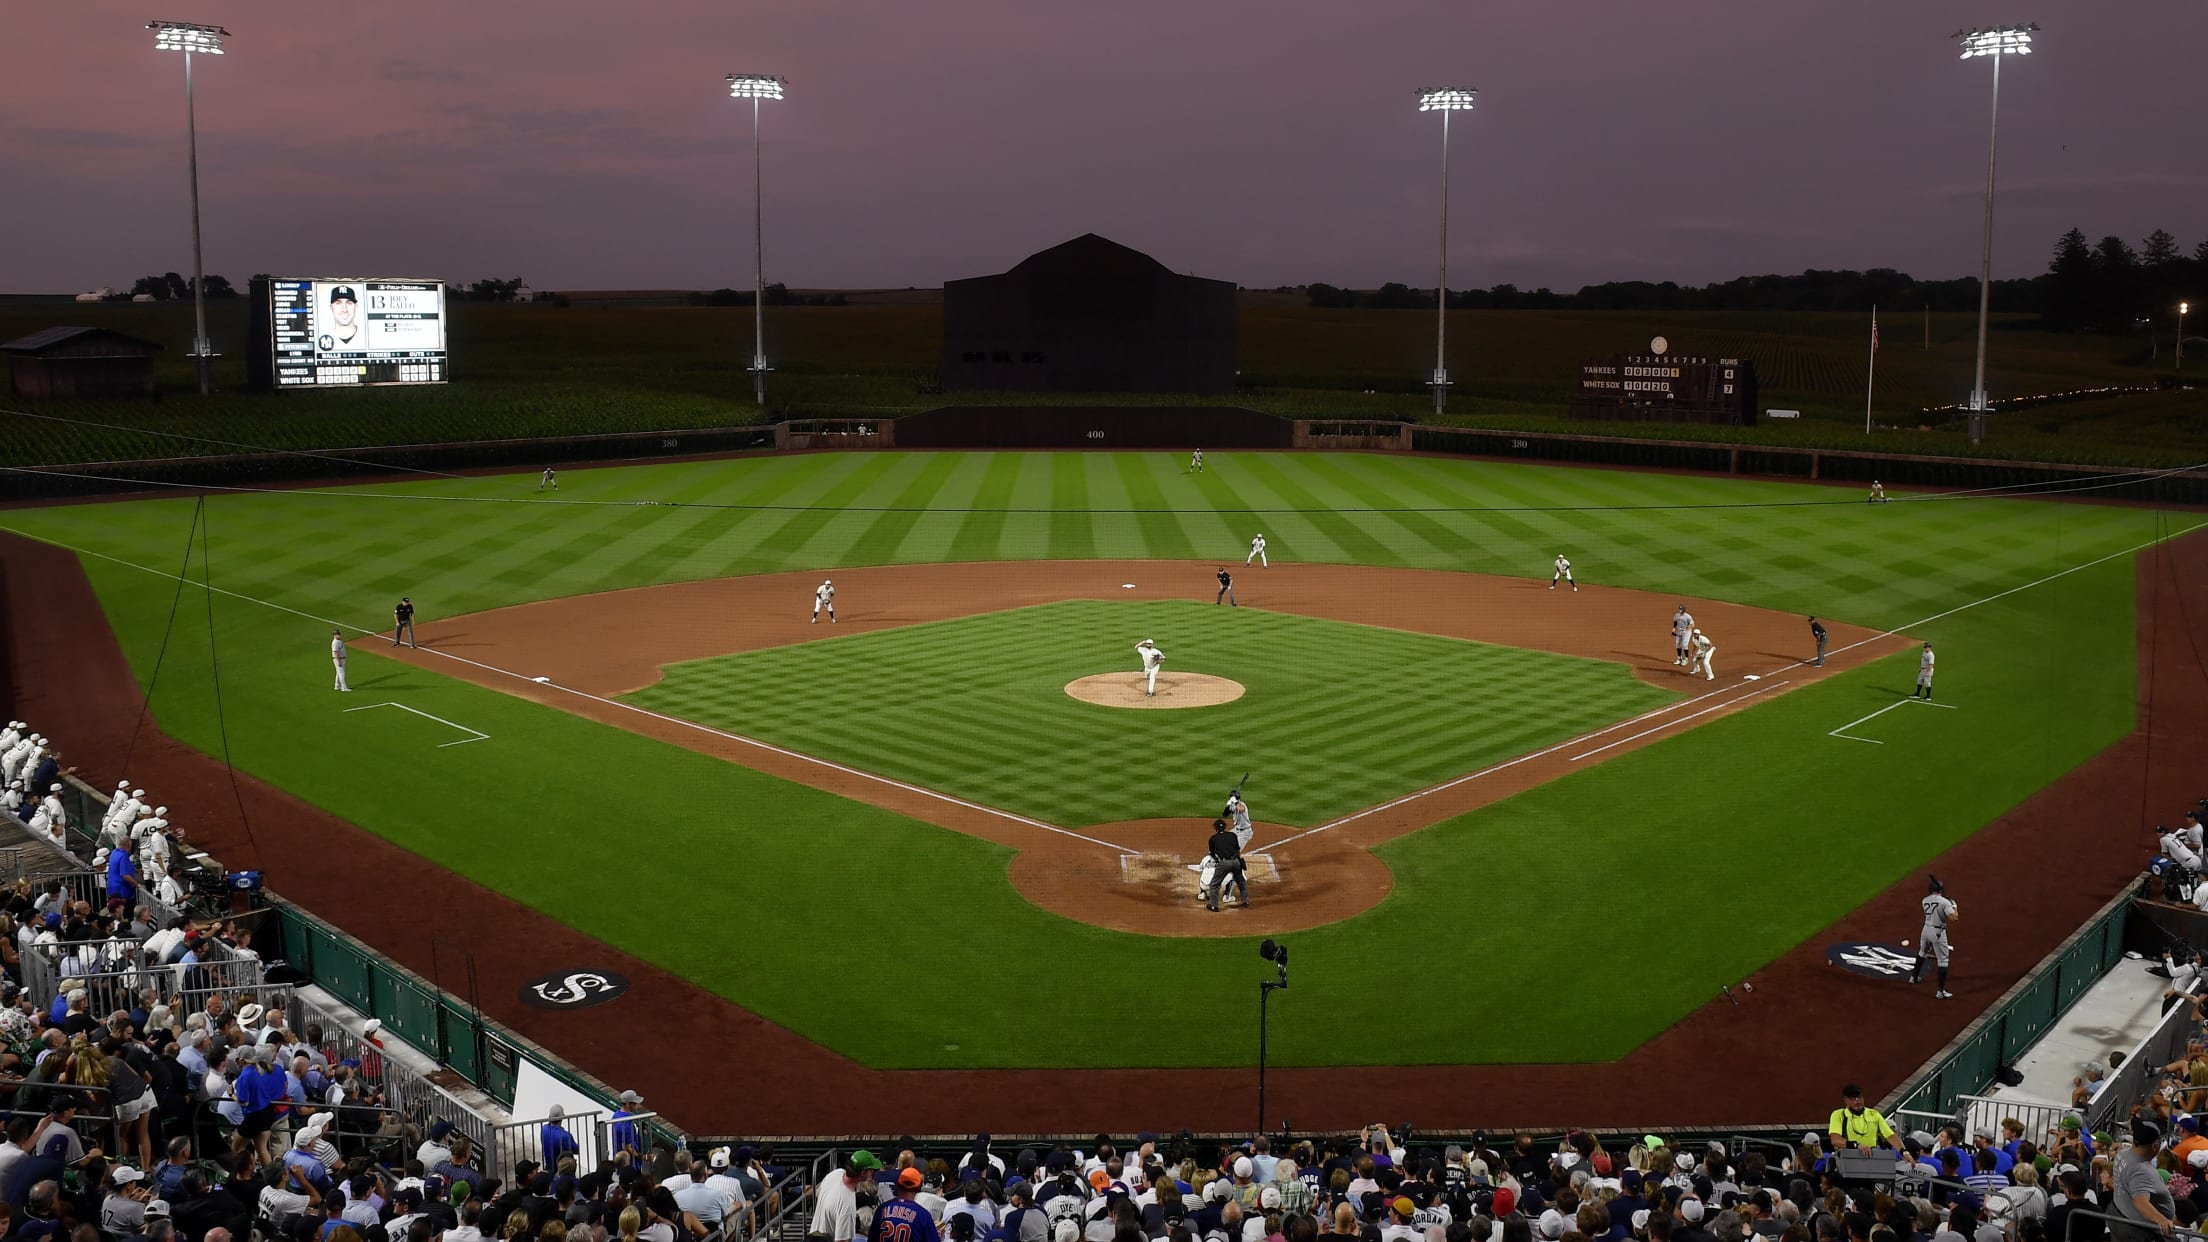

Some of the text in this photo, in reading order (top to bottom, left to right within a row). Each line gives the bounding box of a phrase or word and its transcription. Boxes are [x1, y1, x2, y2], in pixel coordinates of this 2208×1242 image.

[370, 295, 386, 309] 13
[1086, 430, 1105, 439] 400
[661, 439, 677, 448] 380
[1512, 440, 1528, 448] 380
[1924, 902, 1939, 915] 27
[882, 1205, 917, 1222] ALONSO
[1060, 1204, 1074, 1213] DYE
[102, 1208, 114, 1226] 17
[1413, 1213, 1443, 1225] JORDAN
[880, 1220, 911, 1242] 20
